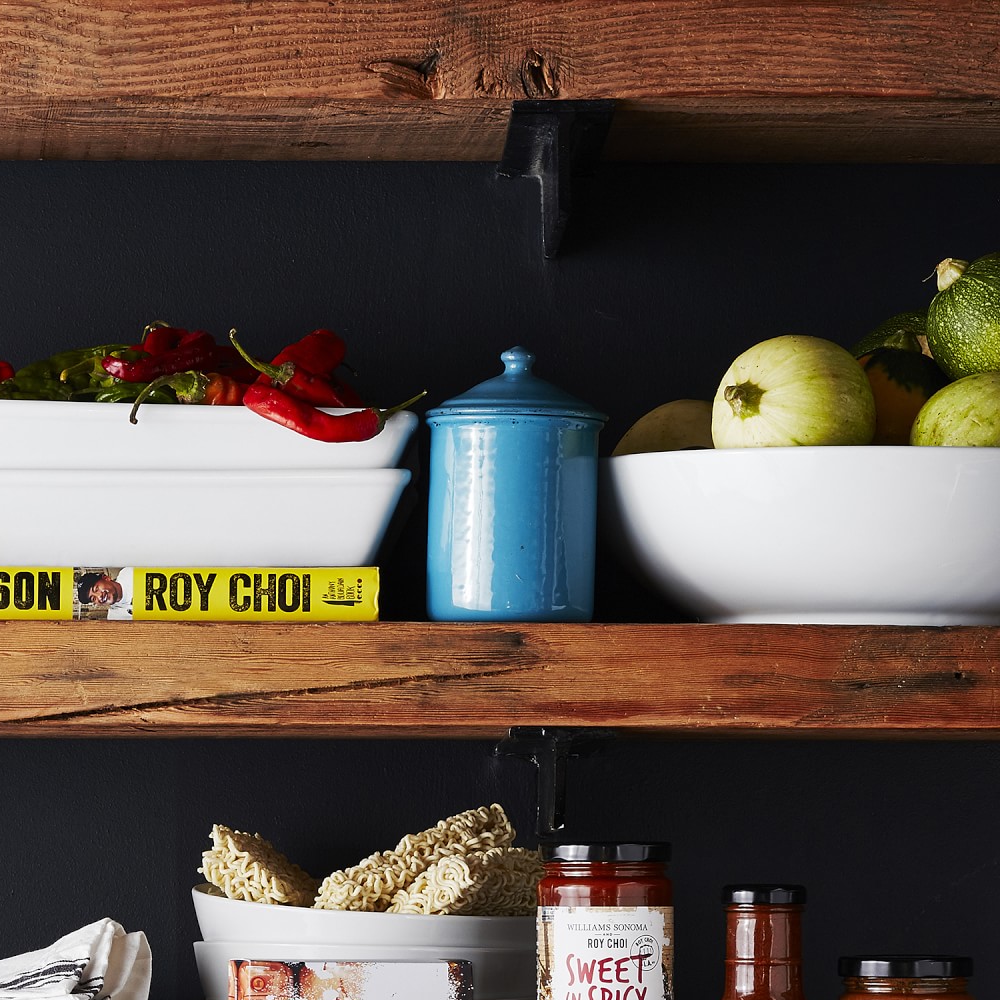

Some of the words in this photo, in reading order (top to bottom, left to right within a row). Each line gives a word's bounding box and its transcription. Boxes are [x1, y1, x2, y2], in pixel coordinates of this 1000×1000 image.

[145, 573, 217, 612] ROY
[228, 573, 311, 613] CHOI
[567, 924, 611, 932] WILLIAMS
[613, 924, 648, 932] SONOMA
[588, 938, 605, 949] ROY
[607, 938, 628, 949] CHOI
[566, 953, 652, 986] SWEET
